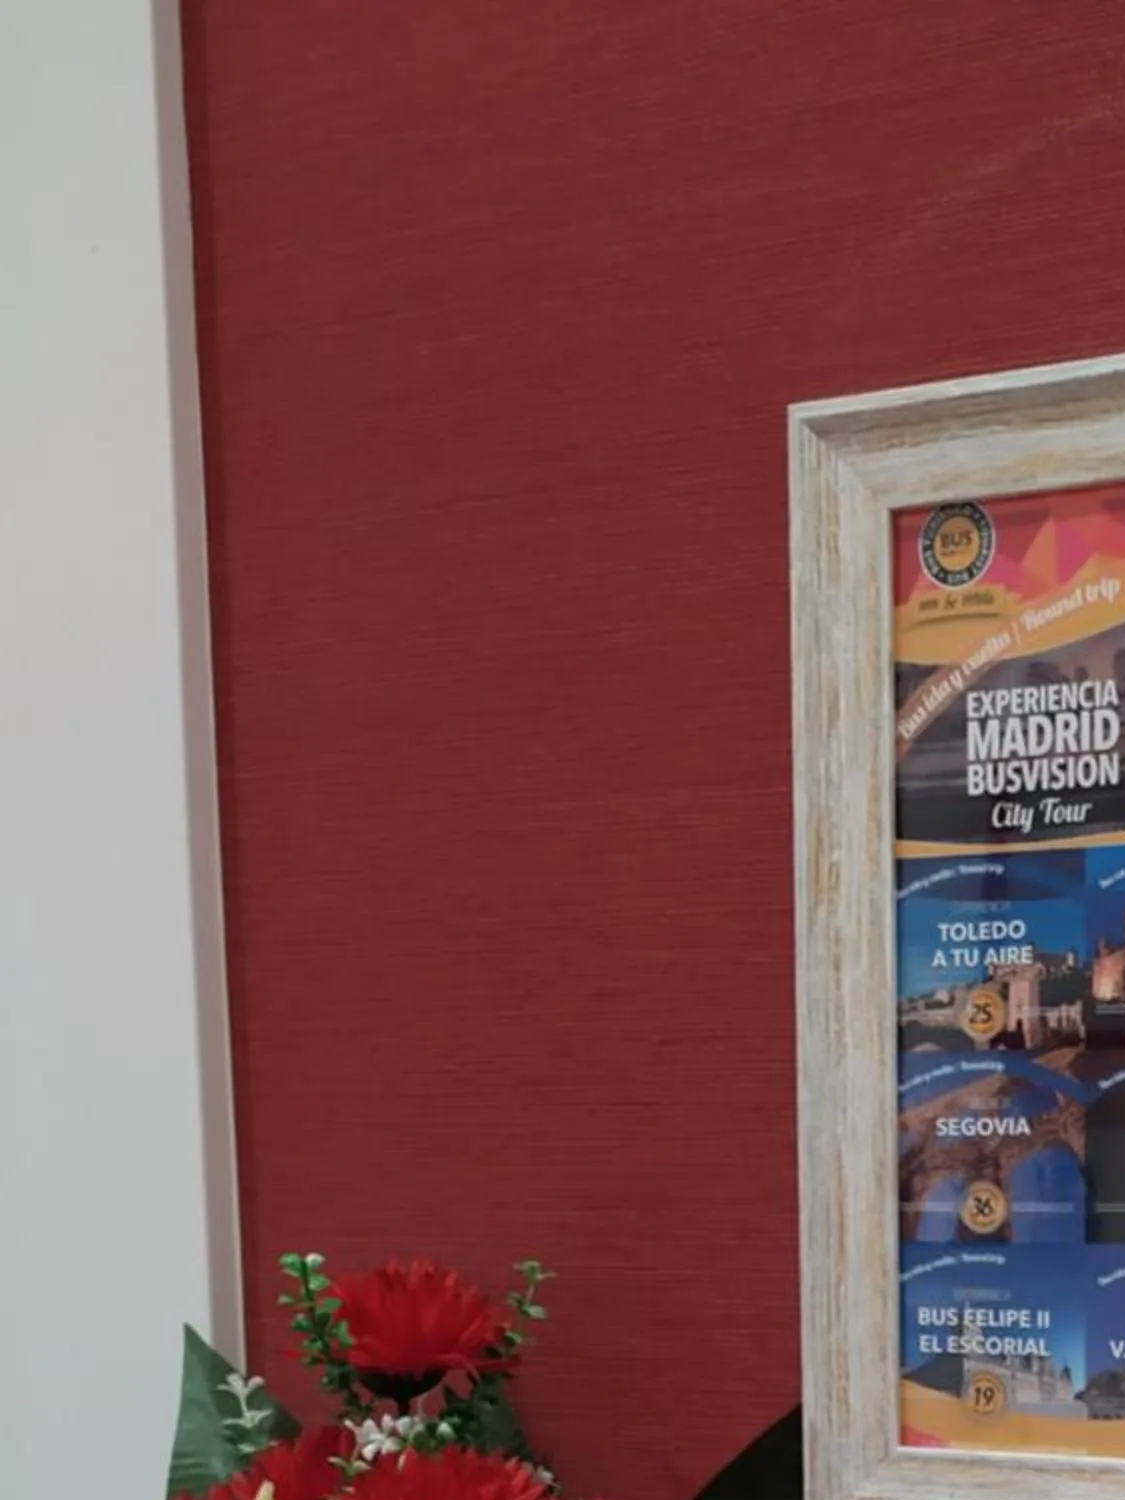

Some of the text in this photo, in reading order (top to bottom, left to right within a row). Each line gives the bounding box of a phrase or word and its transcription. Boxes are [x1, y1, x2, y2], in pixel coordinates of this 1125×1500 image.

[1084, 576, 1122, 602] trip
[967, 679, 1120, 719] EXPERIENCIA
[967, 709, 1121, 762] MADRID
[967, 753, 1120, 797] BUSVISION
[991, 796, 1093, 834] City Tour
[937, 919, 1027, 942] TOLEDO
[931, 945, 1034, 968] A TU AIRE
[935, 1116, 1032, 1137] SEGOVIA
[917, 1306, 959, 1327] BUS
[963, 1308, 1032, 1329] FELIPE
[918, 1335, 1051, 1357] EL ESCORIAL
